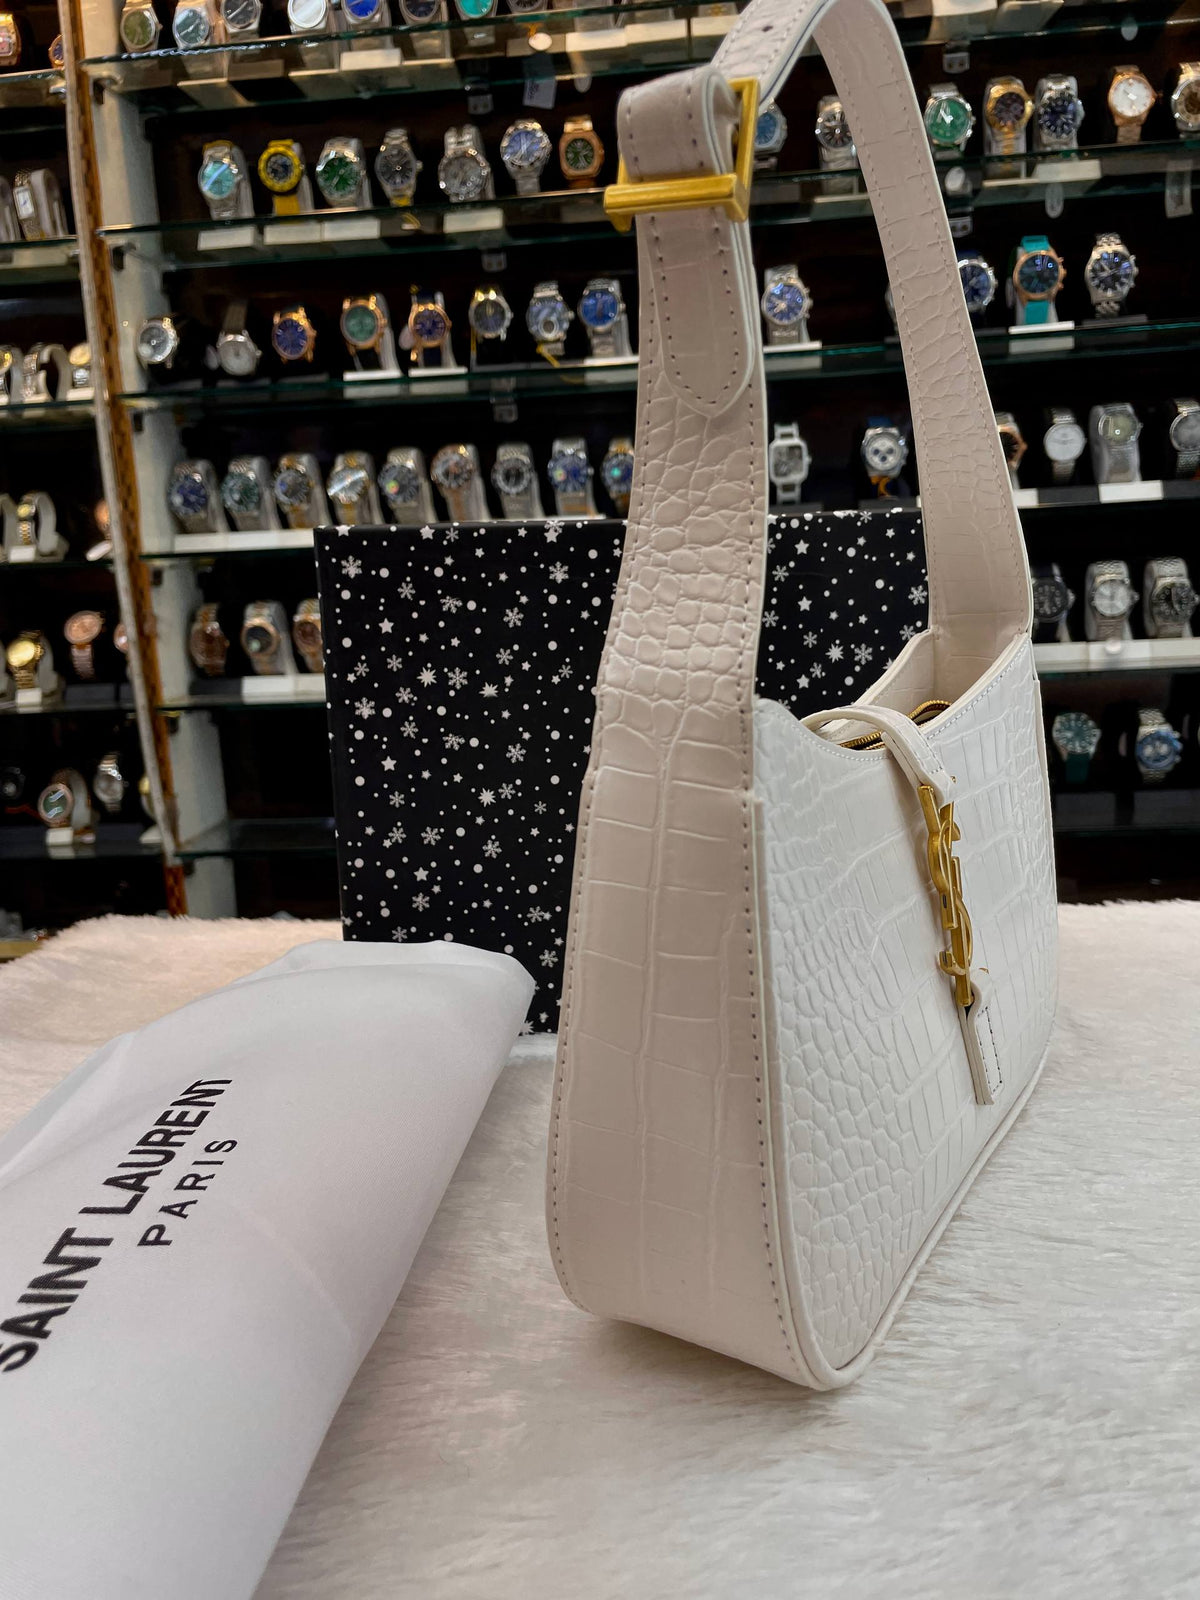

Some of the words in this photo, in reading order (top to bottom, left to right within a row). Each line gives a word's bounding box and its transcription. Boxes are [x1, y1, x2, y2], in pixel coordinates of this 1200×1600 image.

[0, 1227, 114, 1372] SAINT
[79, 1079, 232, 1214] LAURENT
[137, 1139, 238, 1246] PARIS
